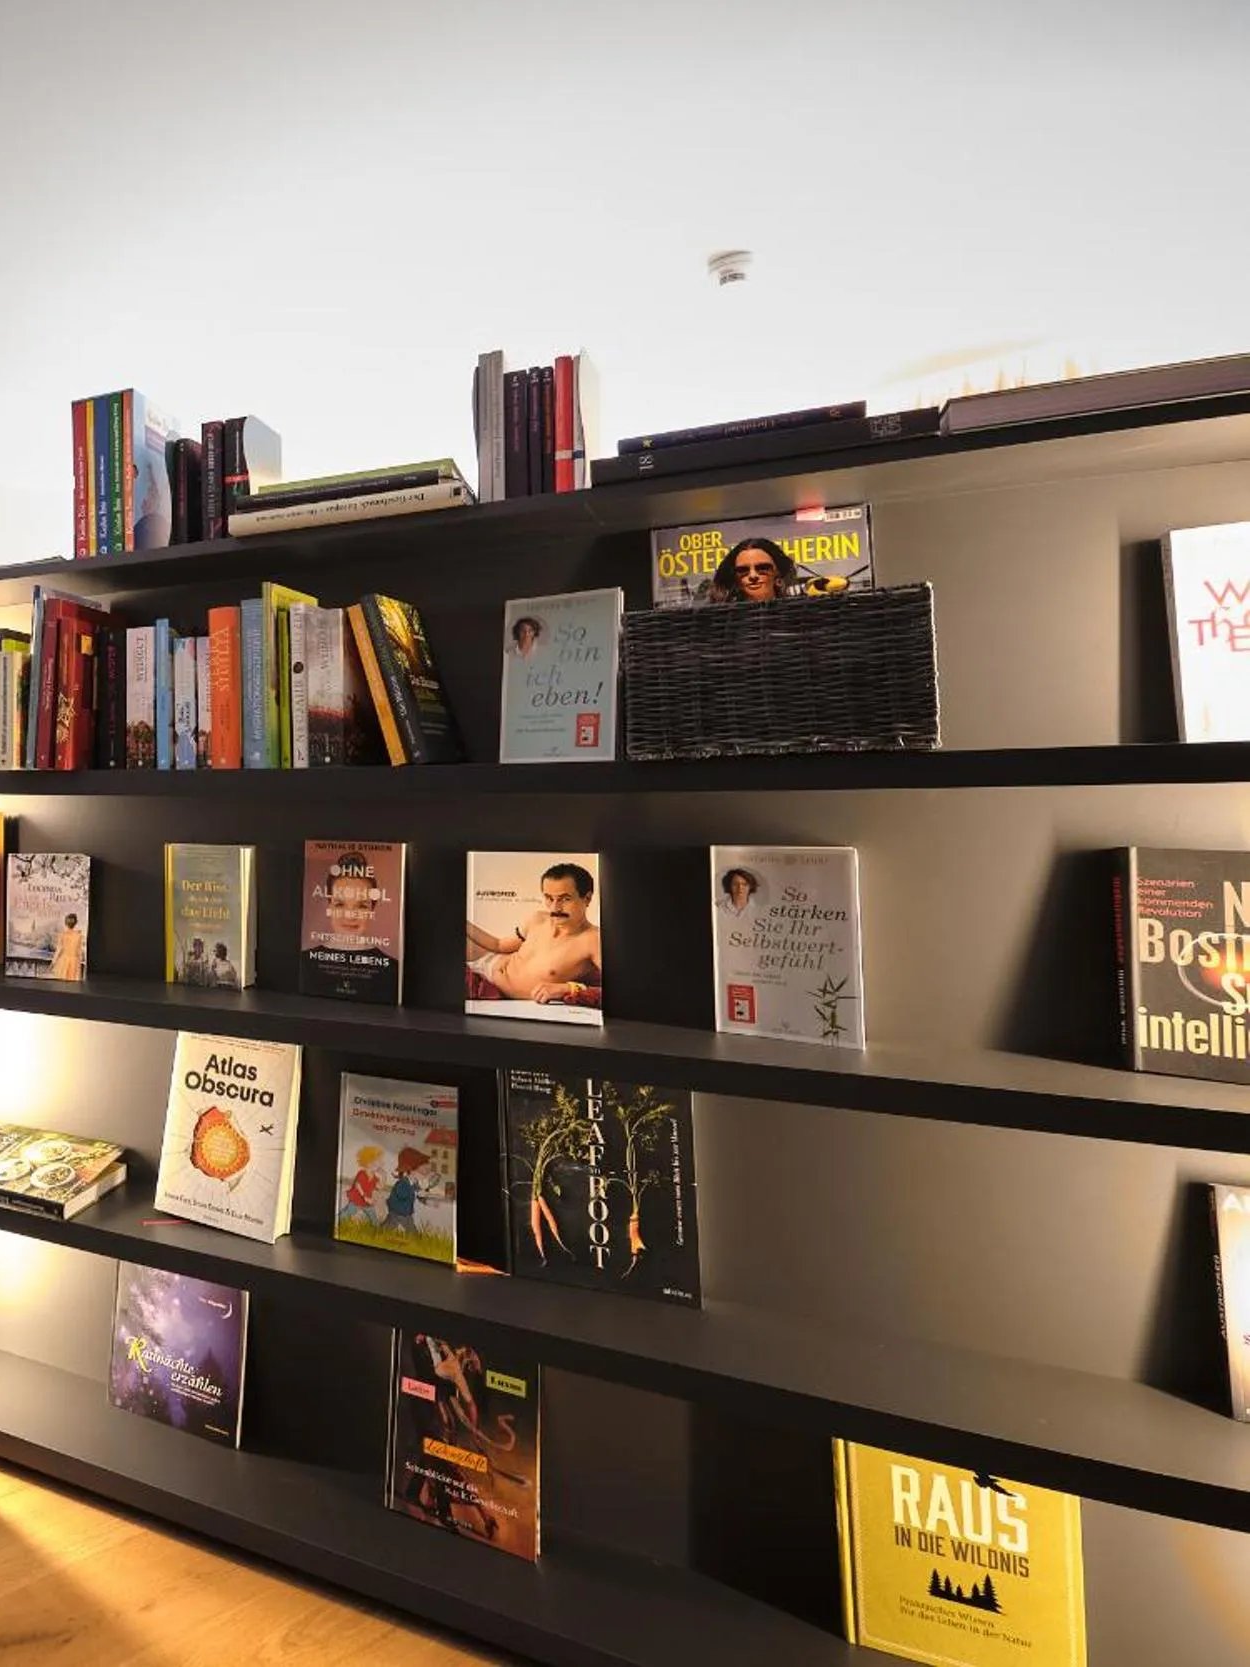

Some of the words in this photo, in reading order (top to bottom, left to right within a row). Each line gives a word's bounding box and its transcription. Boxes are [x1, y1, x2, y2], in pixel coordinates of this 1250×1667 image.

[679, 531, 722, 550] OBER
[531, 681, 604, 708] eben!
[330, 864, 375, 879] OHNE
[312, 886, 392, 903] ALKOHOL
[782, 886, 808, 902] So
[769, 902, 848, 922] stärken
[310, 930, 391, 947] ENTSCHEIDUNG
[752, 918, 786, 935] Sie
[789, 918, 823, 937] Ihr
[728, 931, 846, 958] Selbstwert-
[309, 950, 347, 963] MEINES
[349, 953, 391, 968] LEBENS
[757, 952, 825, 972] gefühl
[1137, 1005, 1250, 1060] intelli
[203, 1053, 258, 1082] Atlas
[185, 1070, 275, 1108] Obscura
[586, 1077, 605, 1168] LEAF
[587, 1175, 611, 1271] ROOT
[170, 1373, 223, 1398] erzählen
[890, 1463, 1030, 1555] RAUS
[894, 1525, 912, 1549] IN
[918, 1530, 946, 1557] DIE
[950, 1538, 1031, 1578] WILDNIS
